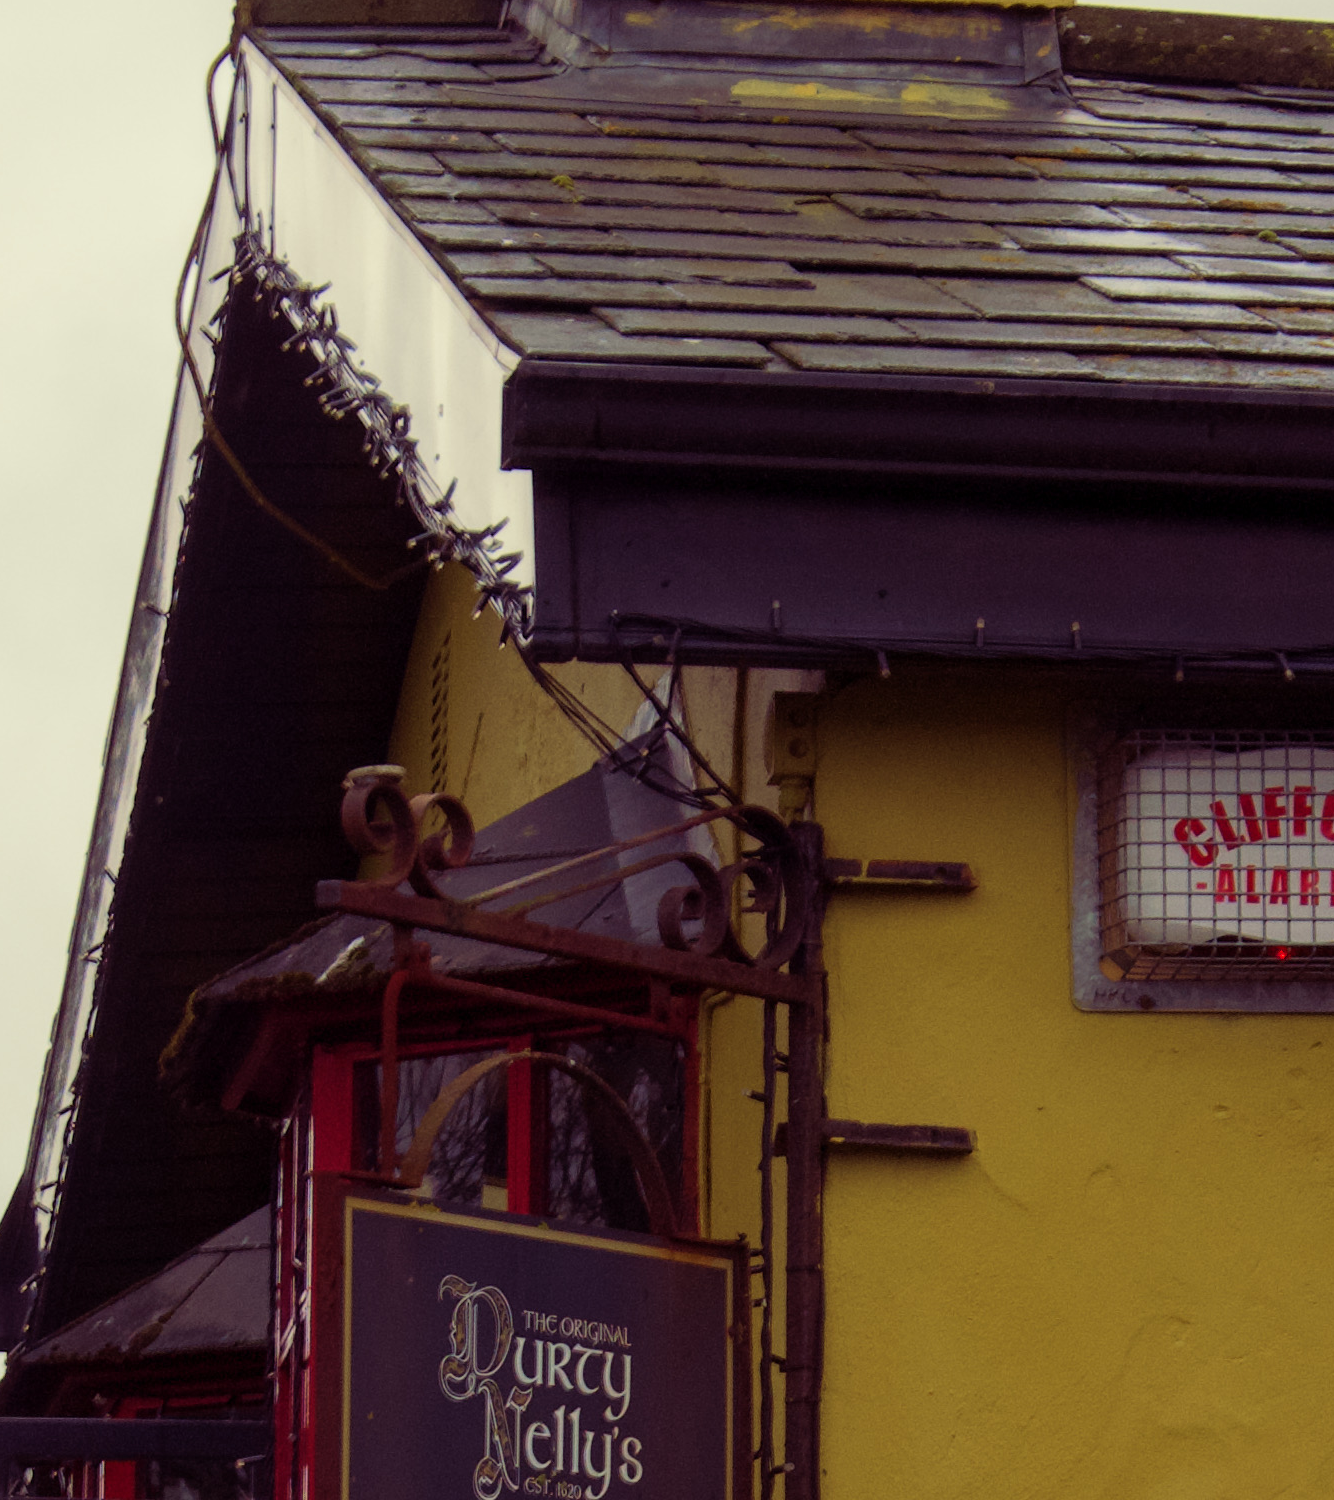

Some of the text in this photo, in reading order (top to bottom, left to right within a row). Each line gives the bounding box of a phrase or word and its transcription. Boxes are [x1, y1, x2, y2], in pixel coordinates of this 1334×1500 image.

[522, 1310, 632, 1348] THE ORIGINAL
[556, 1482, 582, 1500] 1620
